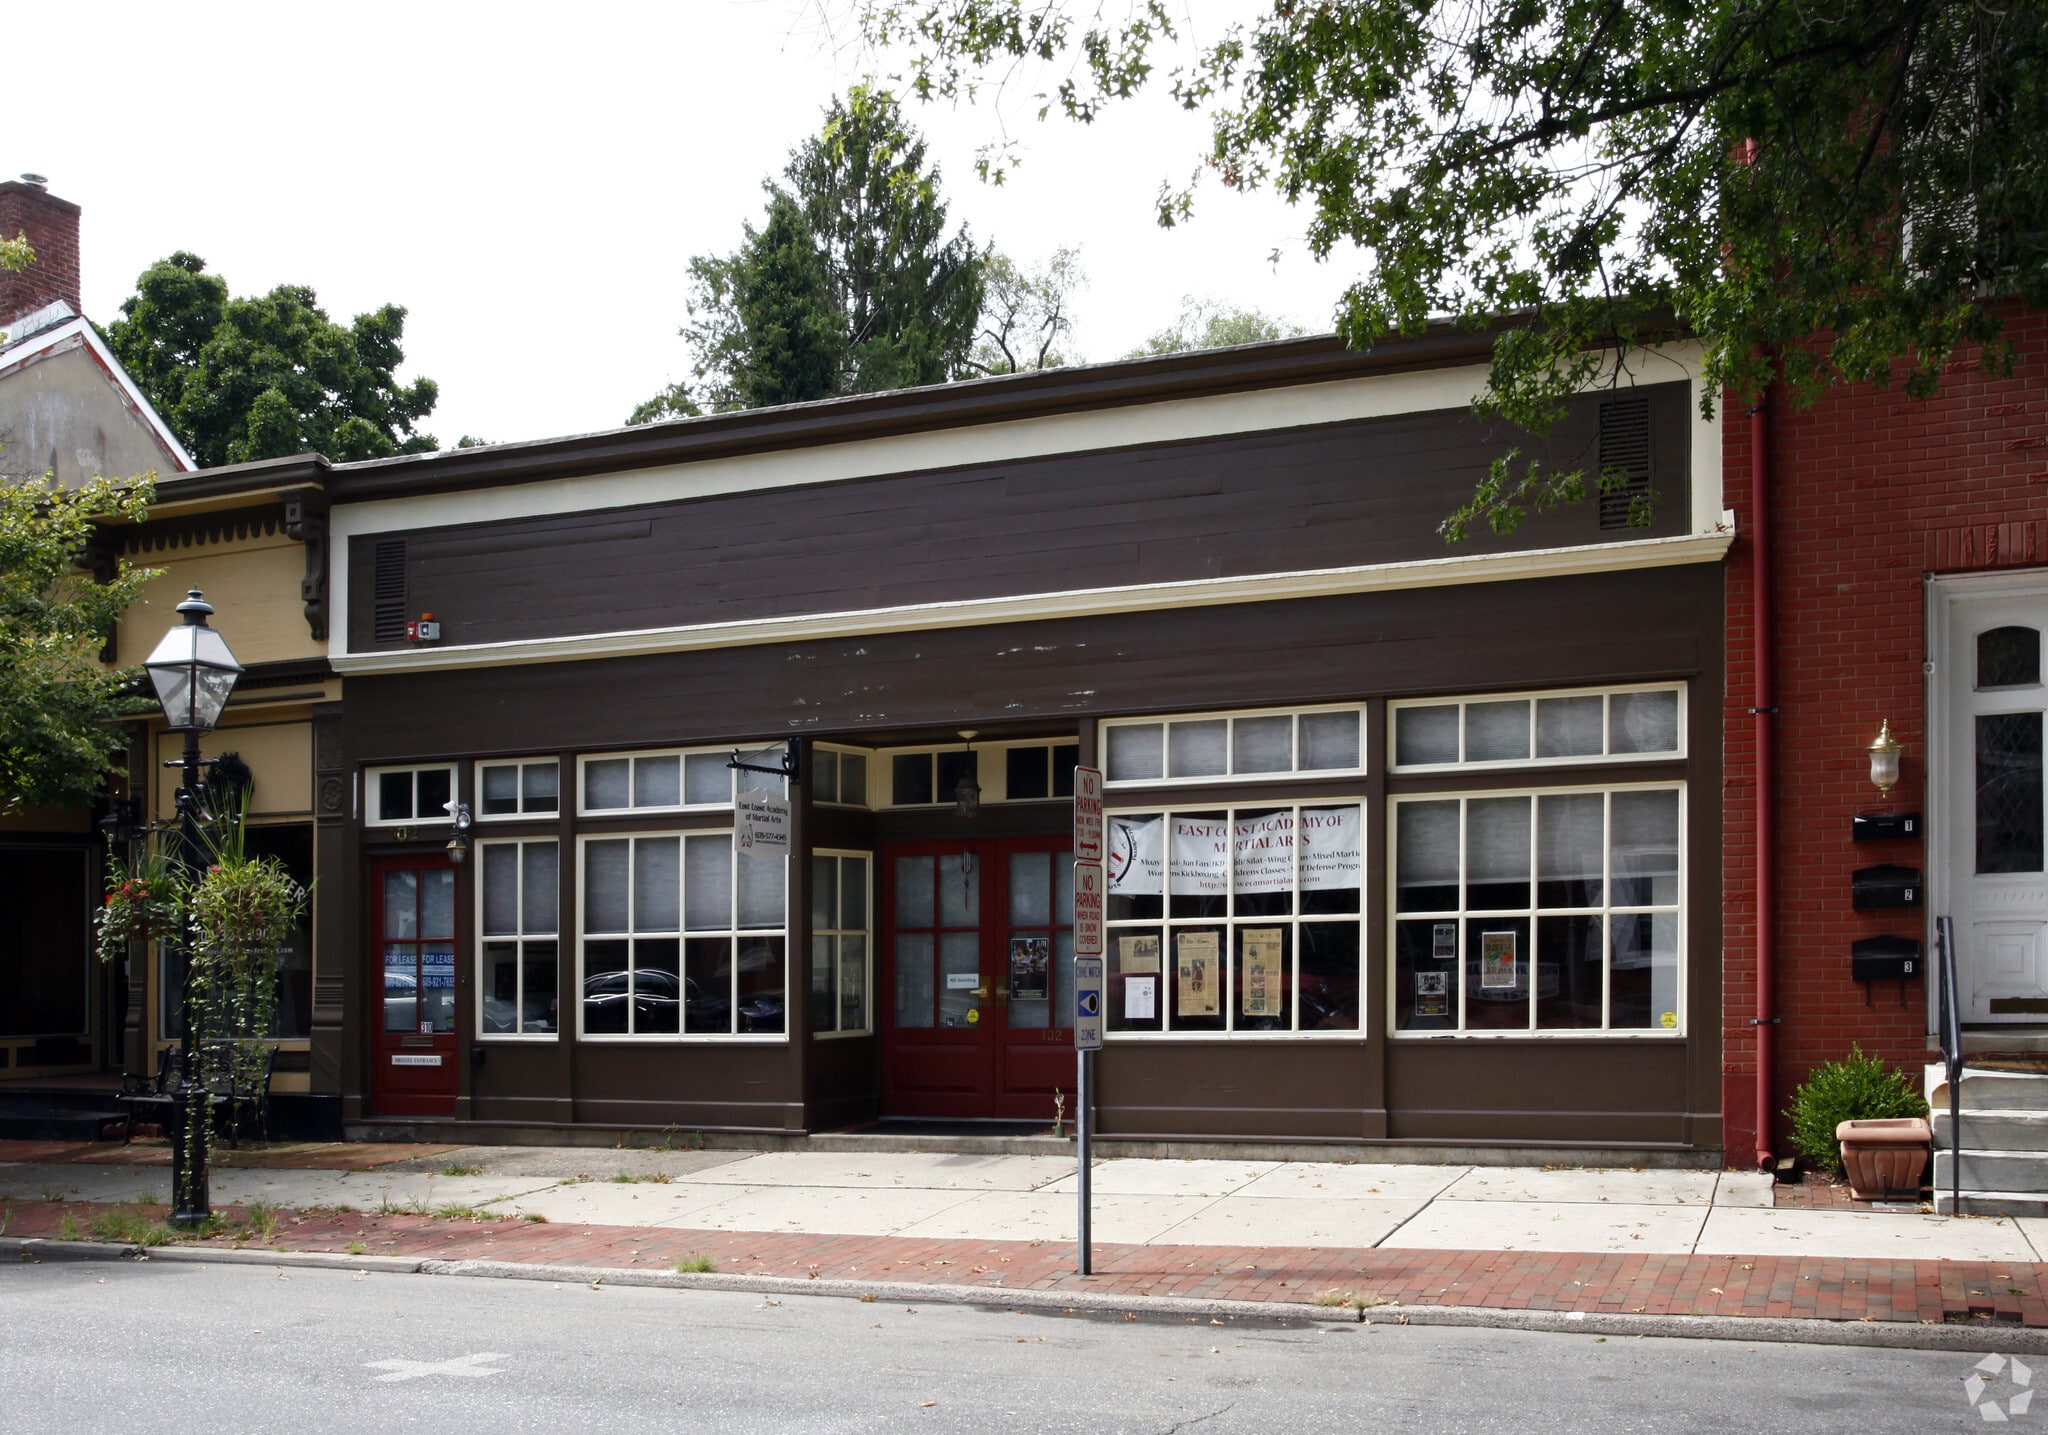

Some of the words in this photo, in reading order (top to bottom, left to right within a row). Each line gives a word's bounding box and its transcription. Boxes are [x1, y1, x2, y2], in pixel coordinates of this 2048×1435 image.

[1083, 777, 1094, 795] NO
[738, 802, 750, 810] East
[751, 803, 765, 811] Coast
[767, 805, 788, 816] Academy
[1076, 795, 1101, 816] PARKING
[752, 814, 770, 822] Martial
[771, 815, 782, 823] Arts
[1178, 824, 1214, 837] EAST
[1259, 816, 1325, 832] ACADMY
[1326, 815, 1345, 827] OF
[1213, 837, 1274, 853] MRTIAL
[1276, 834, 1310, 847] ARS
[1140, 859, 1161, 867] Muay
[1267, 855, 1287, 863] Wing
[1313, 851, 1335, 860] Mixed
[1181, 870, 1219, 879] Kickboxing
[1260, 867, 1286, 875] Classes
[1082, 875, 1093, 892] NO
[1076, 893, 1100, 908] PARKING
[385, 955, 400, 965] FOR
[400, 955, 417, 965] LEASE
[422, 954, 435, 964] FOR
[435, 954, 455, 964] LEASE
[1042, 1030, 1062, 1042] 102
[1081, 1028, 1096, 1041] ZONE
